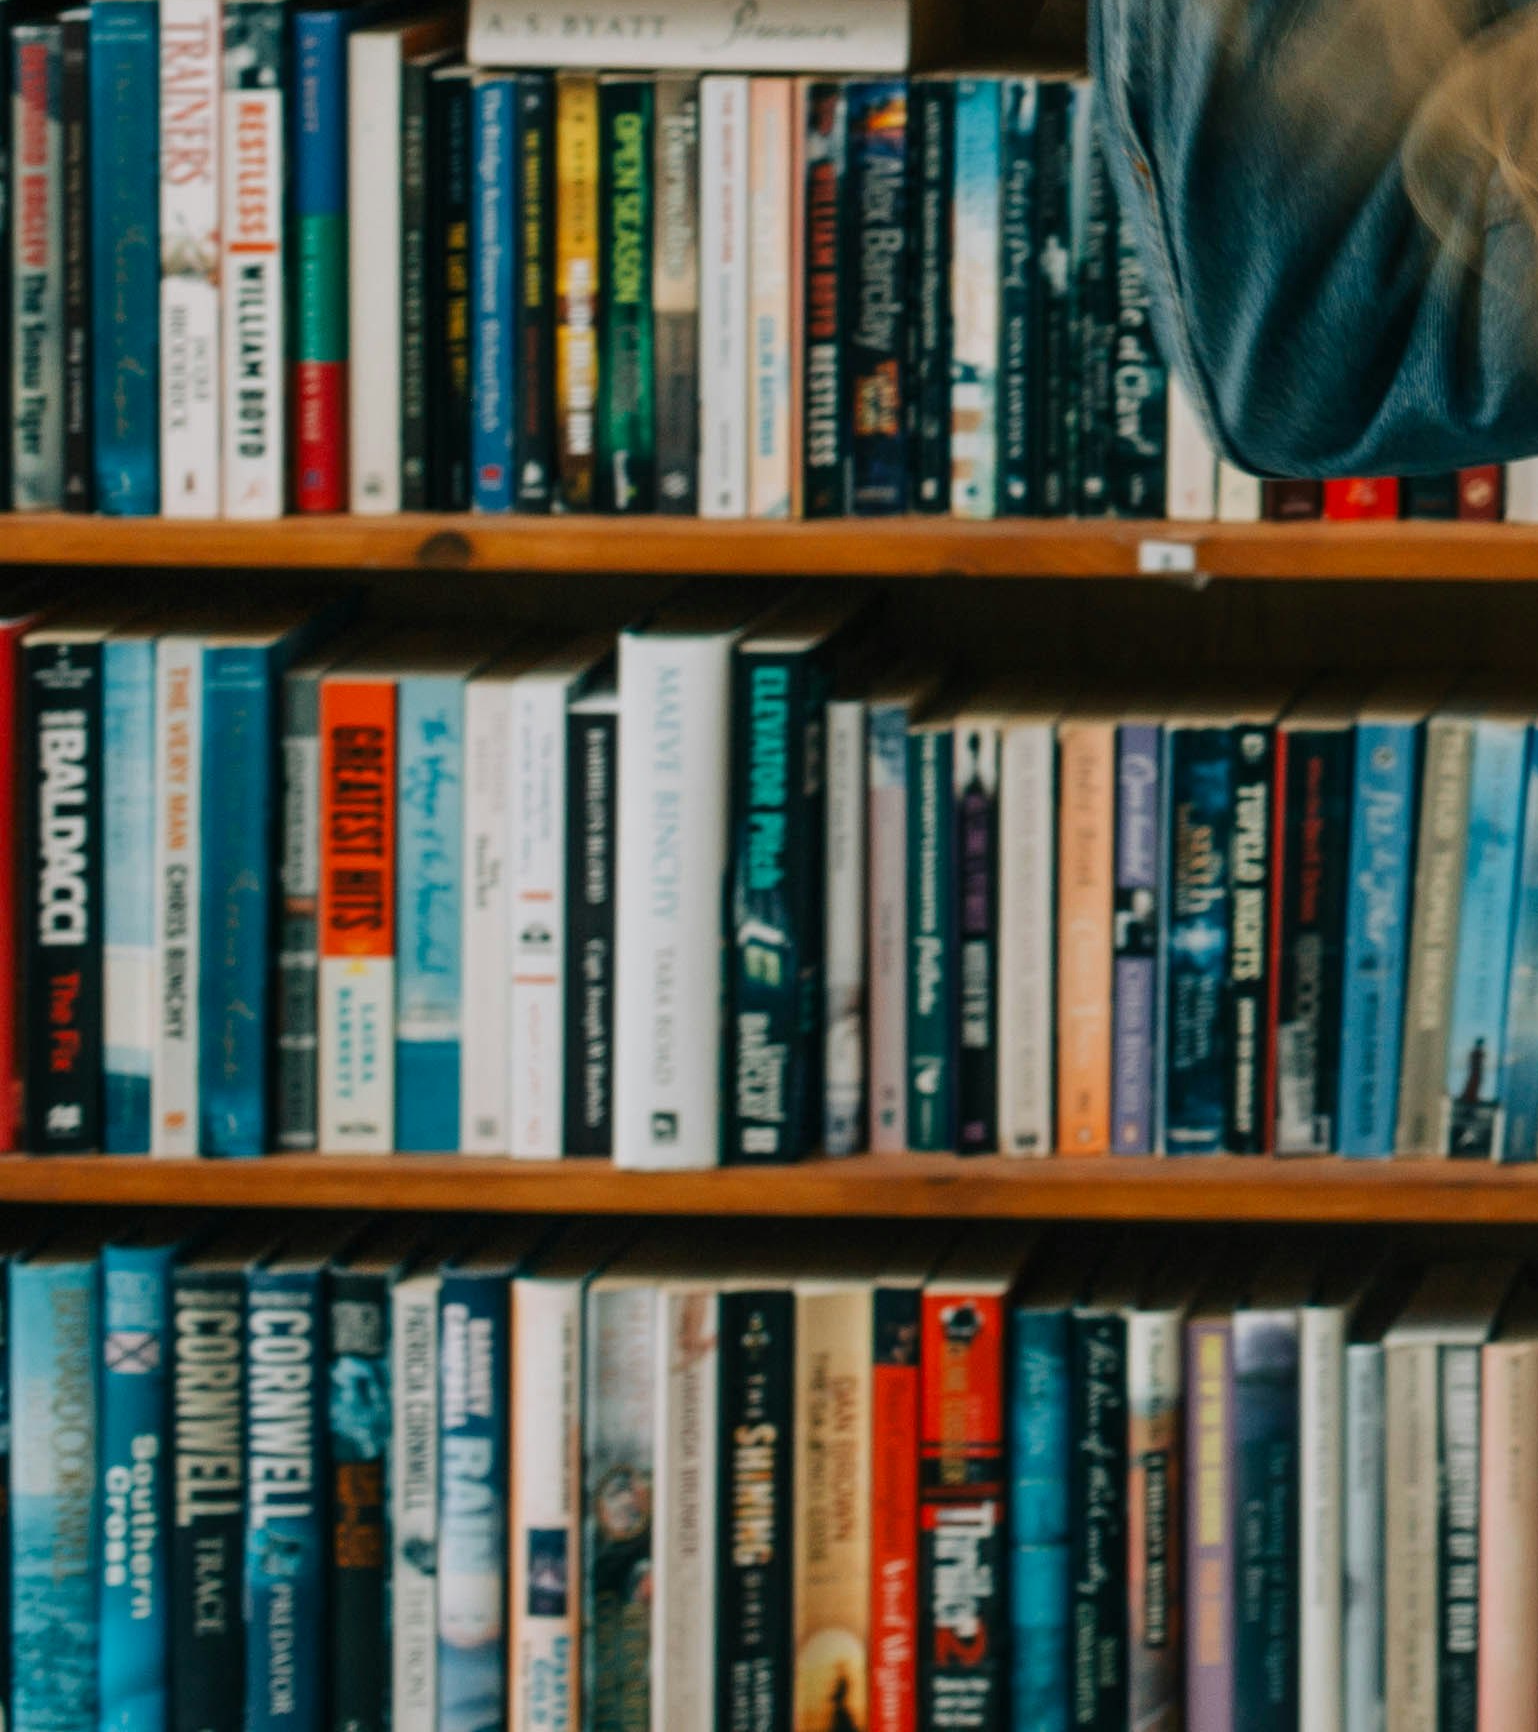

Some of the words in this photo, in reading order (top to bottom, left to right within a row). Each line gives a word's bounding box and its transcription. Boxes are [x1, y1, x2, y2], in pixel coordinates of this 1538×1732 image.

[560, 14, 667, 38] BYATT
[163, 16, 213, 187] TRAINERS
[612, 113, 644, 186] OPEN
[237, 100, 269, 237] RESTLESS
[809, 165, 837, 267] WILLIAM
[863, 153, 903, 221] Alex
[611, 192, 644, 304] SEASON
[853, 227, 903, 353] Barclay
[237, 261, 269, 381] WILLIAM
[809, 272, 837, 338] BOYD
[237, 388, 267, 460] BOYD
[808, 343, 837, 467] RESTLESS
[168, 666, 190, 716] THE
[653, 664, 682, 777] MAEVE
[750, 666, 790, 807] ELEVATOR
[167, 723, 189, 783] VERY
[331, 726, 384, 859] GREATEST
[40, 729, 88, 947] BALDACCI
[167, 793, 188, 851] MAN
[653, 790, 681, 921] BINCHY
[748, 812, 784, 890] Pitch
[1231, 781, 1266, 884] TUPELO
[163, 863, 188, 940] CHRIS
[331, 868, 384, 930] HITS
[1231, 888, 1266, 981] NIGHTS
[51, 972, 80, 1023] The
[161, 946, 188, 1042] BINCHY
[336, 986, 355, 1100] BARNETT
[359, 1003, 377, 1083] LAURA
[51, 1030, 79, 1072] Fix
[176, 1309, 241, 1527] CORNWELL
[249, 1309, 313, 1529] CORNWELL
[831, 1374, 857, 1433] DAN
[402, 1403, 430, 1513] CORNWELL
[443, 1435, 493, 1572] RAIN
[732, 1423, 777, 1568] SHINING
[832, 1438, 857, 1542] BROWN
[105, 1464, 131, 1587] Cross
[131, 1433, 158, 1620] Southern
[933, 1500, 995, 1637] Thriller
[193, 1533, 226, 1635] TRACE
[267, 1582, 296, 1716] PREDATOR
[936, 1634, 989, 1665] 2
